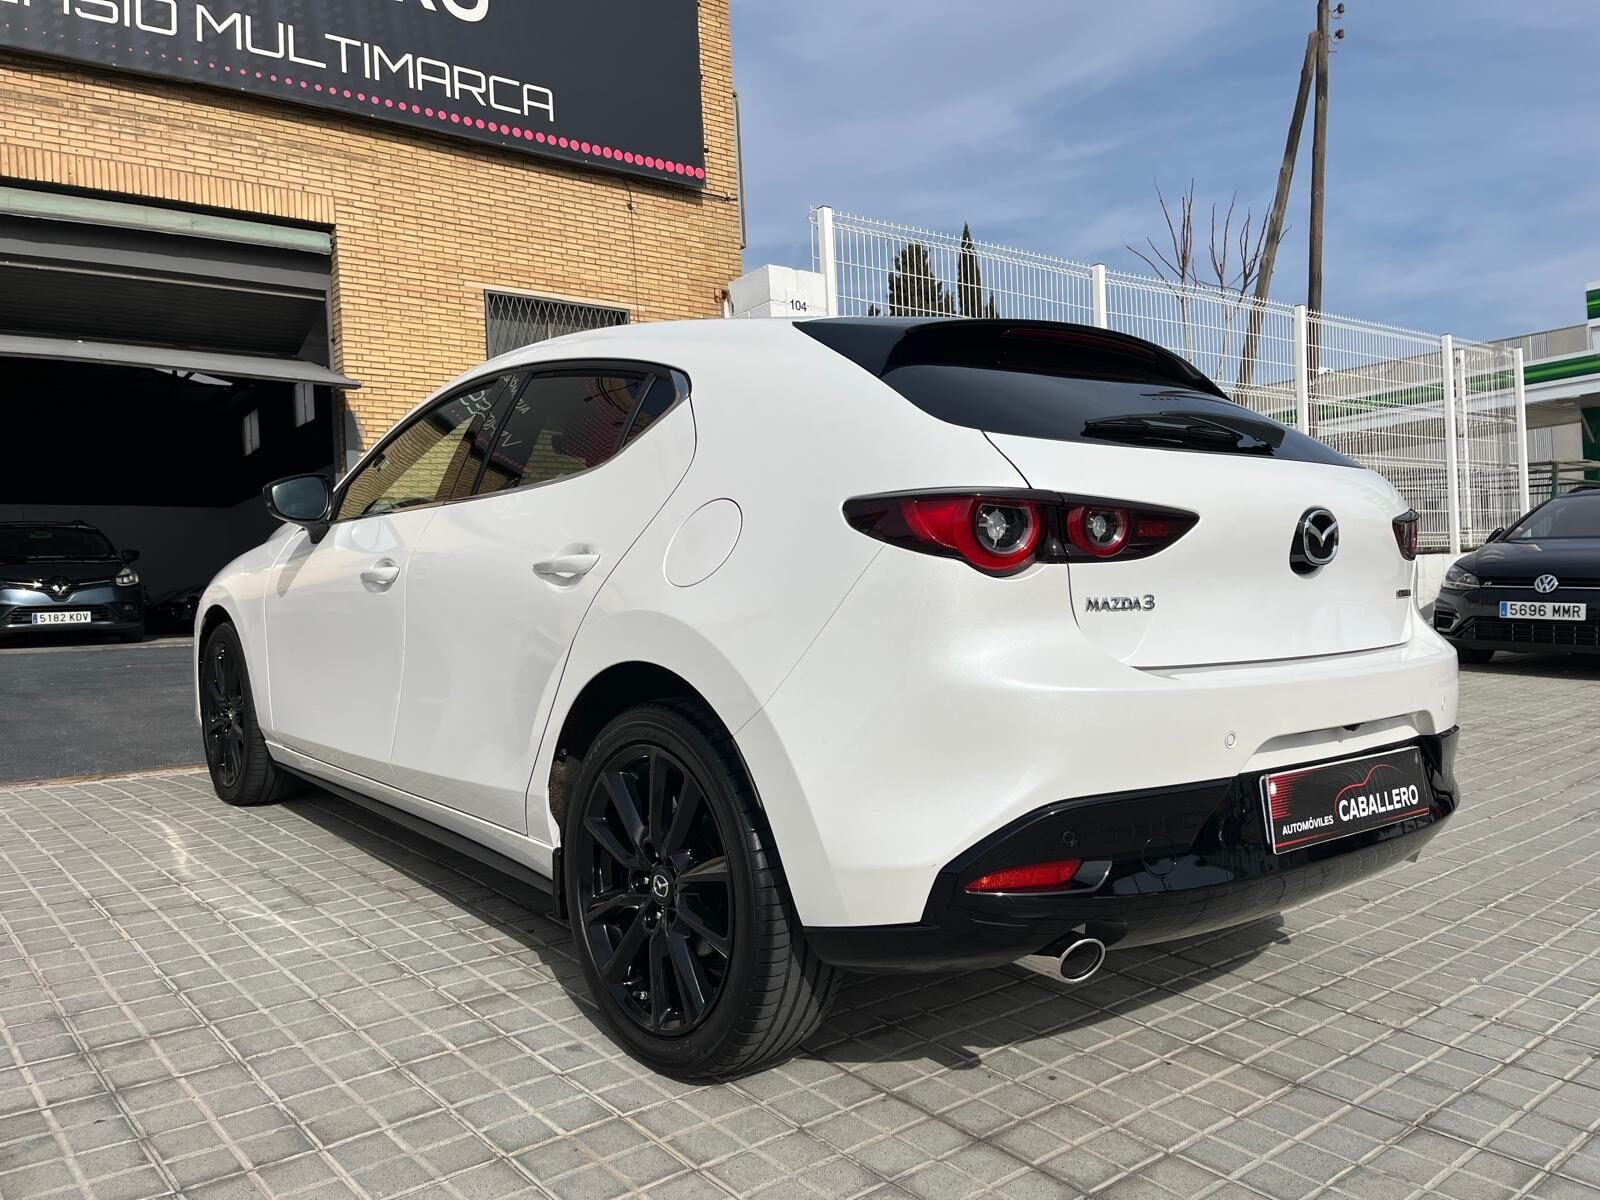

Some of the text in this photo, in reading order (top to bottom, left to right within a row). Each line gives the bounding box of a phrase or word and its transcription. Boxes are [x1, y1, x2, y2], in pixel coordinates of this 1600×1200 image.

[196, 4, 554, 122] MULTIMARCA
[790, 299, 807, 312] 104
[1086, 594, 1156, 612] MAZDA3
[1509, 603, 1581, 618] 5696 MMR
[39, 612, 88, 623] 5182 KDV
[1282, 784, 1419, 836] AUTOMÓVILES CABALLERO
